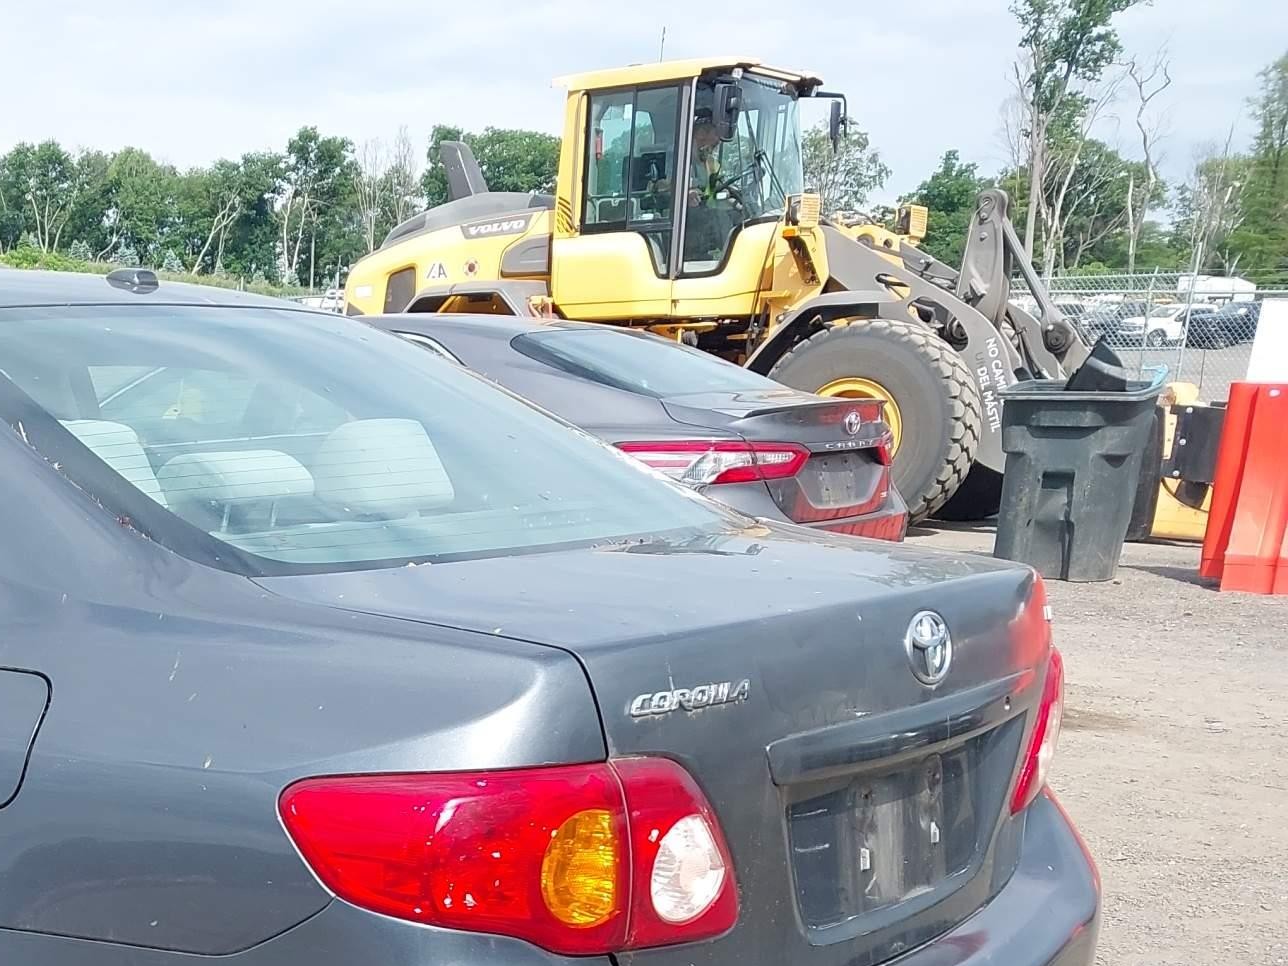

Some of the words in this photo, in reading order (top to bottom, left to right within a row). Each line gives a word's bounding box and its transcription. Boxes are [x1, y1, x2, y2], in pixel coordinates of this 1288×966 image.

[469, 219, 526, 235] VOLVO
[985, 337, 999, 357] NO
[977, 366, 991, 391] DEL
[630, 679, 751, 717] COROLLA
